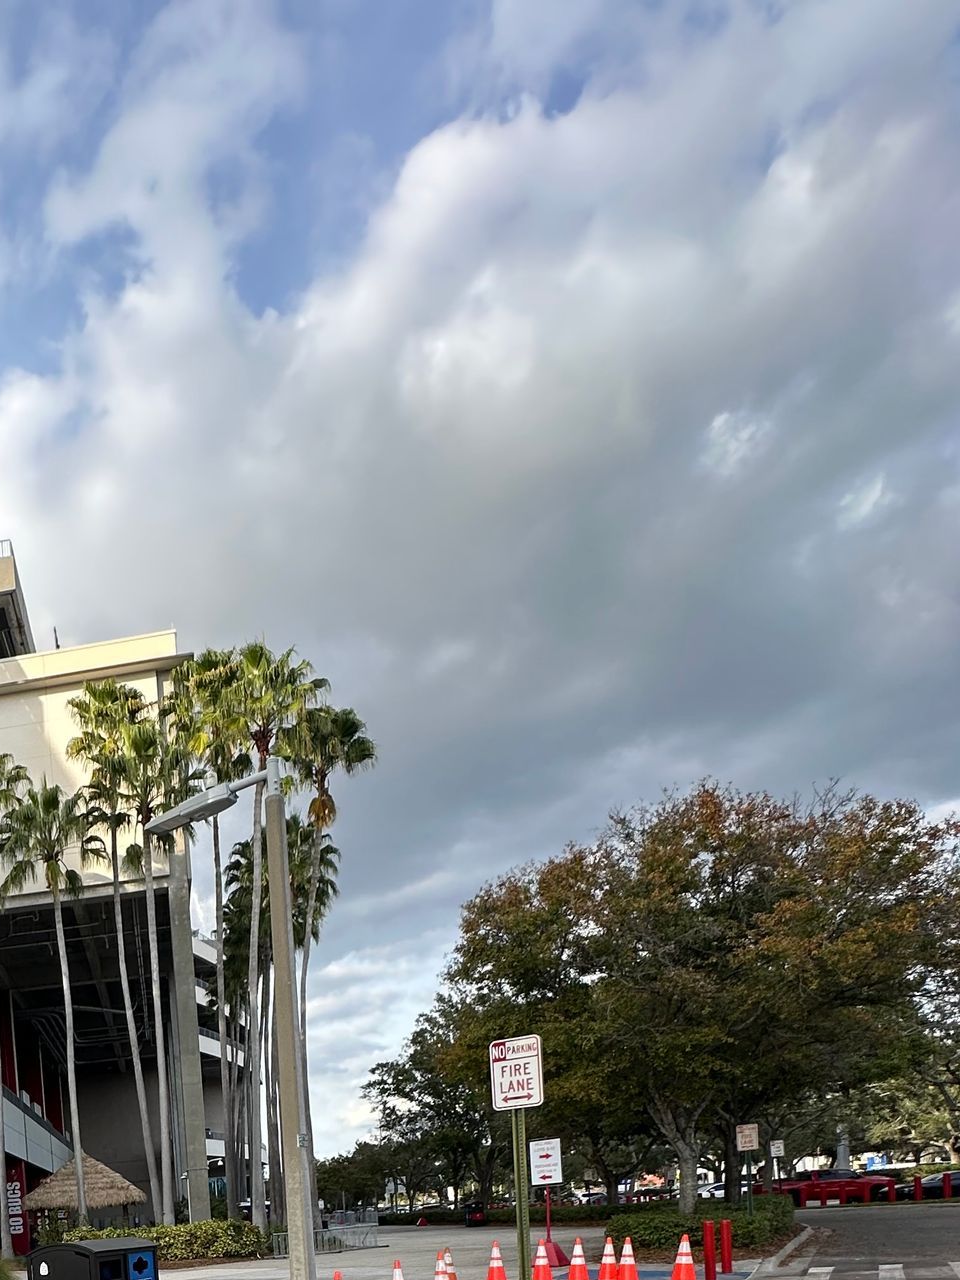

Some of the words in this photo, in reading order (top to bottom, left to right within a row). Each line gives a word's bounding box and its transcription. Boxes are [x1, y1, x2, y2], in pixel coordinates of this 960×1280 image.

[492, 1045, 506, 1060] NO
[507, 1042, 537, 1054] PARKING
[501, 1062, 531, 1078] FIRE
[500, 1077, 534, 1094] LANE
[6, 1181, 22, 1215] BUCS
[9, 1216, 24, 1234] GO
